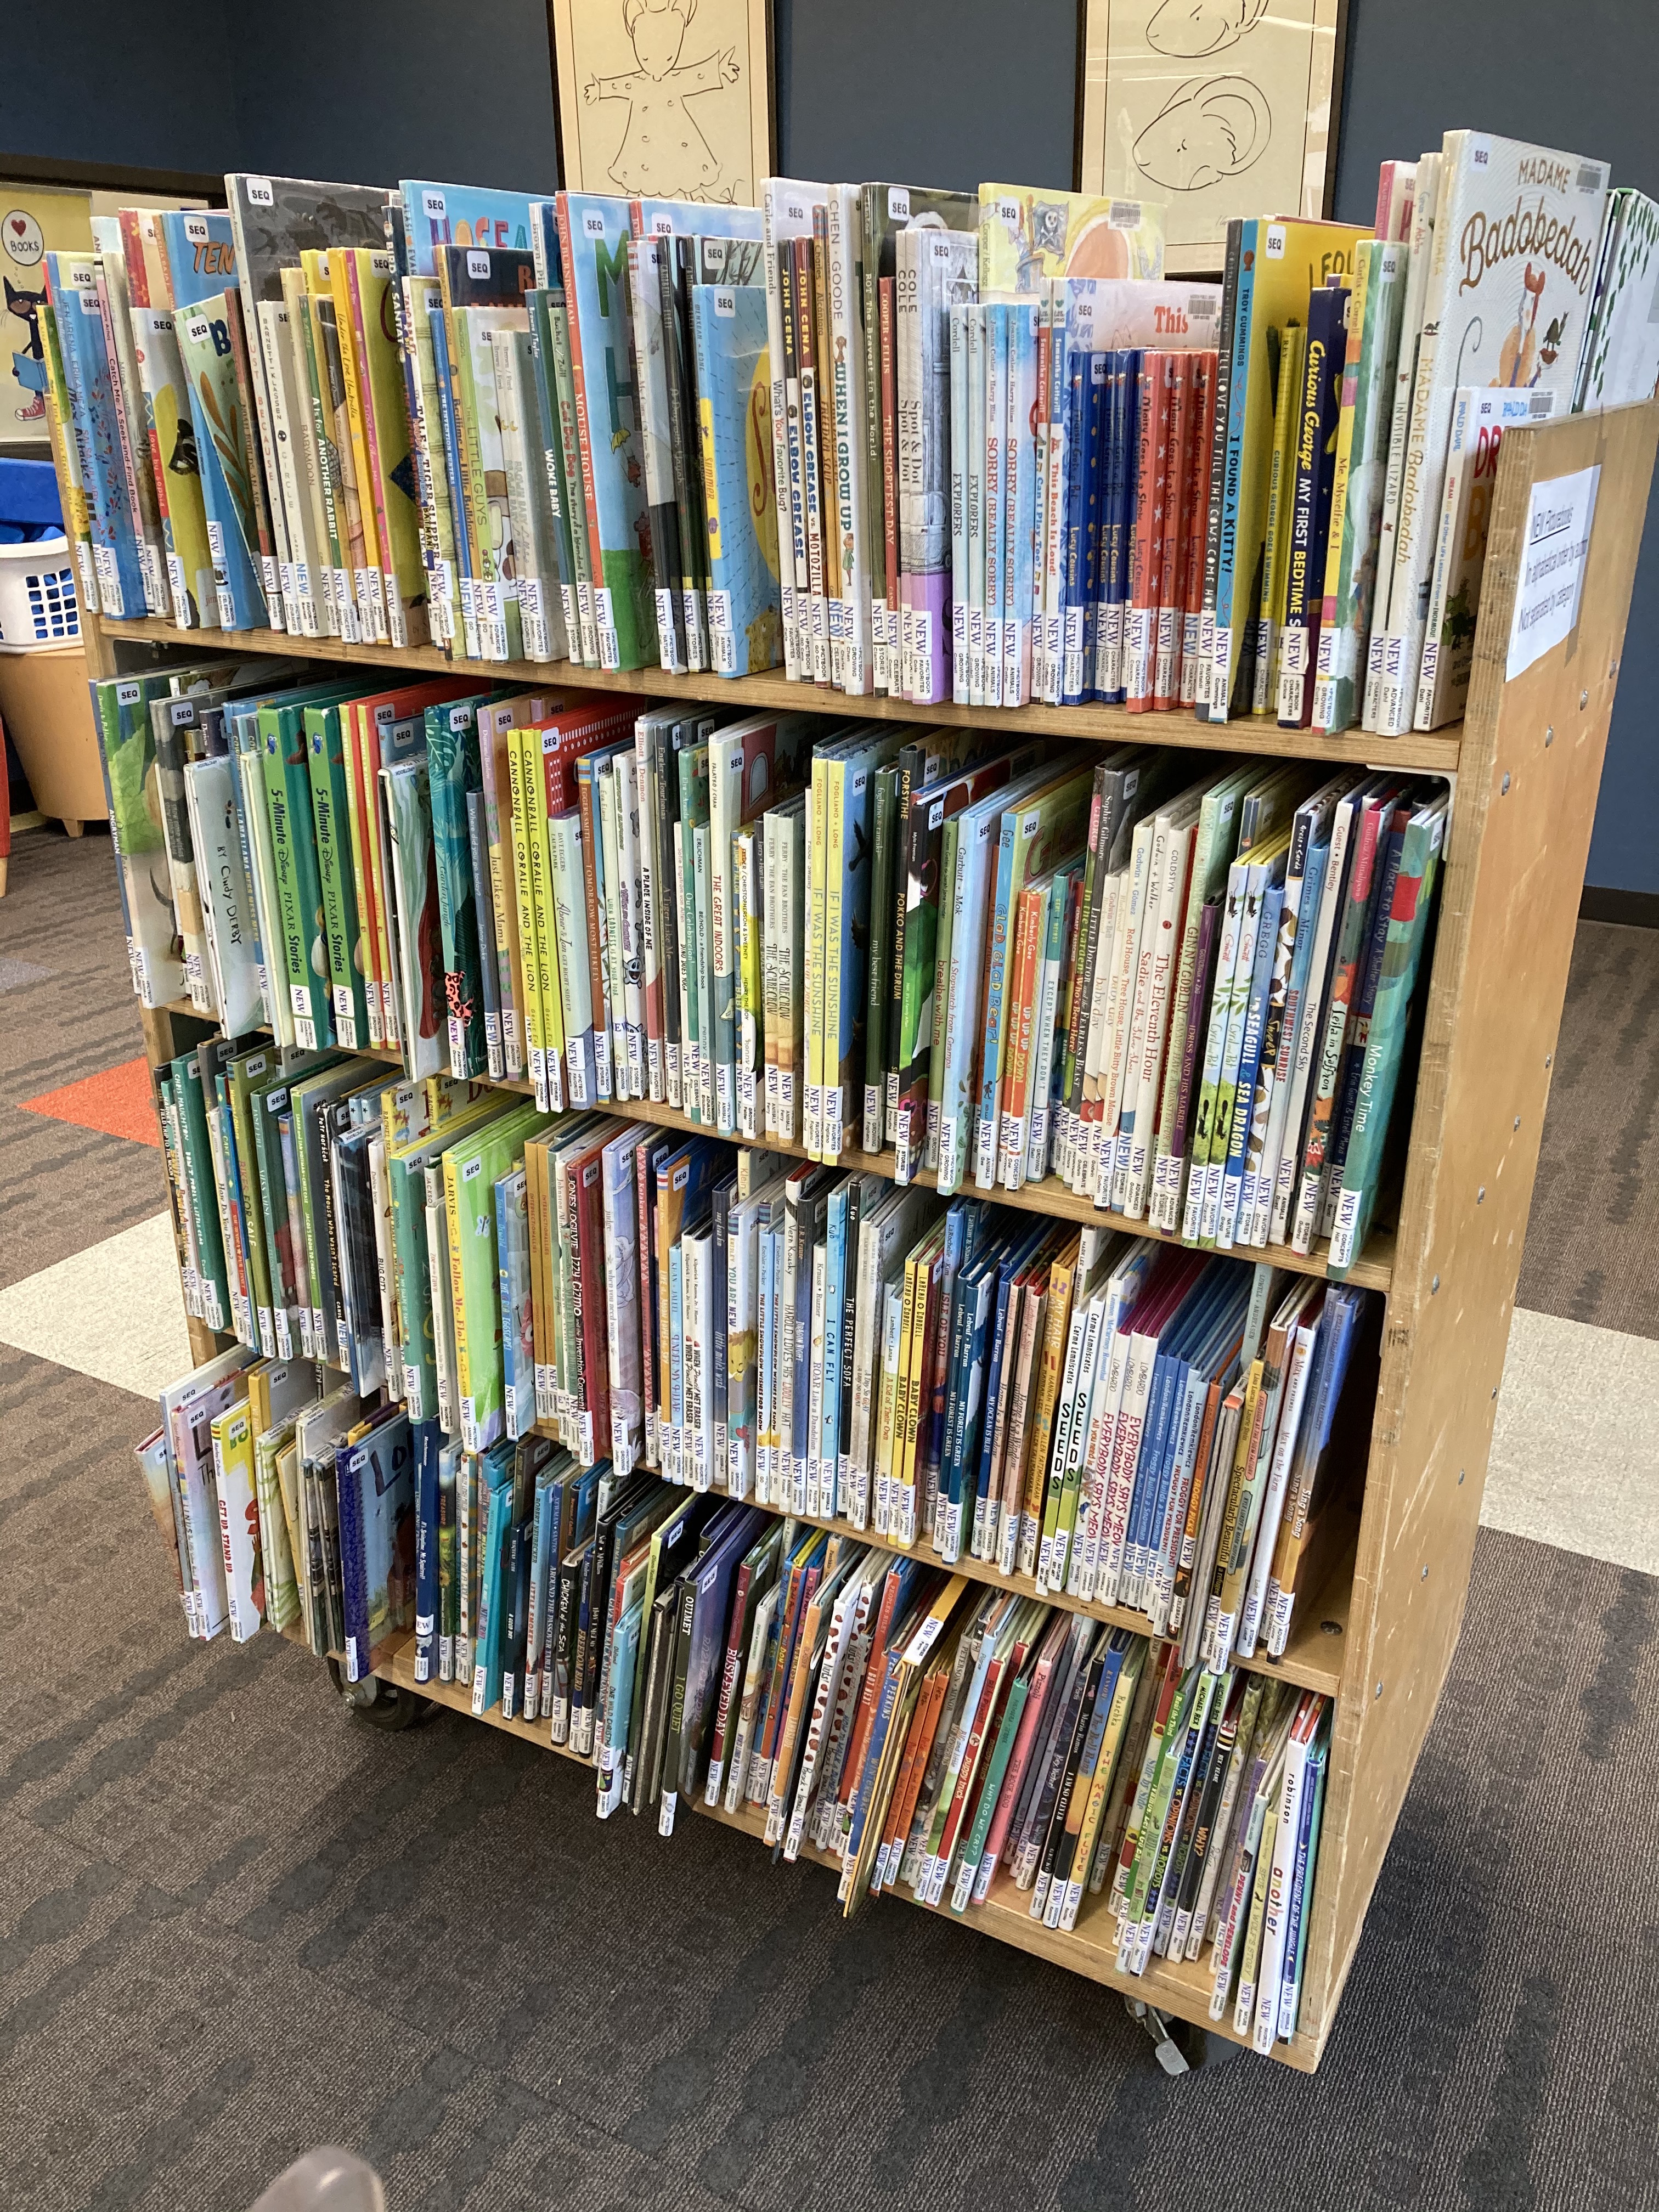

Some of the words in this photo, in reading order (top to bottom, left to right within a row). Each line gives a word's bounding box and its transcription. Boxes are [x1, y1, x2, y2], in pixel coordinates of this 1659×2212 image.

[1474, 150, 1488, 164] SEQ
[1517, 158, 1571, 194] MADAME
[252, 190, 270, 200] SEQ
[764, 194, 773, 228] Carle
[788, 207, 803, 218] SEQ
[189, 225, 206, 235] SEQ
[558, 214, 567, 246] JOHN
[830, 200, 840, 244] CHEN
[10, 240, 40, 251] BOOKS
[193, 241, 236, 275] TEN
[934, 246, 949, 257] SEQ
[1268, 238, 1281, 250] SEQ
[1459, 195, 1592, 297] Badobedah
[472, 263, 488, 273] SEQ
[766, 247, 775, 295] Friends
[561, 248, 575, 325] BURNINGHAM
[799, 268, 808, 308] JOHN
[832, 261, 843, 320] GOODE
[908, 269, 917, 313] COLE
[1240, 288, 1250, 313] TROY
[191, 326, 207, 337] SEQ
[337, 313, 346, 341] Under
[800, 314, 809, 356] CENA
[1154, 306, 1188, 334] This
[1237, 315, 1247, 367] CUMMINGS
[343, 358, 352, 378] Love
[1308, 340, 1325, 409] Curious
[346, 379, 357, 419] Umbrella
[772, 380, 782, 416] What's
[835, 363, 848, 424] WHEN
[575, 393, 588, 449] MOUSE
[775, 417, 783, 444] Your
[804, 393, 815, 446] ELBOW
[911, 400, 921, 434] Spot
[1392, 401, 1405, 462] INVISIBLE
[109, 358, 119, 387] Catch
[119, 418, 133, 487] Seek-and-Find
[128, 488, 137, 513] Book
[911, 441, 922, 451] &
[1297, 413, 1320, 470] George
[302, 425, 315, 486] BABYMOON
[318, 439, 331, 495] ANOTHER
[544, 449, 556, 485] WOKE
[775, 444, 785, 486] Favorite
[838, 444, 850, 503] GROW
[912, 457, 922, 484] Dot
[987, 438, 998, 494] SORRY
[1227, 448, 1239, 498] FOUND
[1338, 457, 1348, 476] Me,
[281, 452, 294, 508] CIRCLE
[579, 452, 592, 501] HOUSE
[806, 449, 817, 513] GREASE
[1298, 478, 1311, 503] MY
[1387, 463, 1401, 505] LIZARD
[549, 488, 562, 518] BABY
[779, 488, 787, 512] Bug?
[953, 473, 962, 537] EXPLORERS
[1051, 492, 1059, 524] Beach
[1226, 503, 1235, 515] A
[1331, 482, 1346, 527] Myselfie
[324, 498, 337, 540] RABBIT
[840, 507, 851, 531] UP
[987, 498, 997, 555] (REALLY
[1050, 526, 1057, 539] Is
[1294, 507, 1309, 546] FIRST
[1331, 531, 1340, 540] &
[1223, 518, 1235, 574] KITTY!
[168, 560, 179, 588] NEW
[809, 533, 821, 596] MOTOZILLA
[987, 557, 997, 606] SORRY)
[1290, 550, 1306, 614] BEDTIME
[221, 595, 231, 623] CELEBRATE
[916, 619, 927, 654] NEW
[1387, 638, 1401, 676] NEW
[176, 709, 193, 719] SEQ
[453, 713, 469, 725] SEQ
[1389, 687, 1397, 727] ADVANCED
[524, 750, 538, 834] CANNONBALL
[901, 769, 910, 820] FORSYTHE
[109, 809, 121, 854] ANGRYMAN
[270, 789, 285, 845] 5-Minute
[1024, 821, 1037, 834] SEQ
[1334, 826, 1345, 855] Guest
[278, 845, 291, 885] Disney
[532, 842, 543, 896] CORALIE
[1167, 849, 1179, 893] GOLDSTYN
[1325, 861, 1339, 891] Bentley
[217, 846, 225, 859] BY
[221, 865, 233, 899] Cindy
[227, 905, 242, 945] DERBY
[713, 875, 721, 892] THE
[283, 891, 296, 931] PIXAR
[536, 904, 545, 928] AND
[713, 895, 723, 927] GREAT
[896, 893, 905, 927] POKKO
[539, 936, 548, 959] THE
[714, 930, 724, 972] INDOORS
[895, 930, 904, 950] AND
[1257, 911, 1272, 958] GREGG
[289, 934, 301, 974] Stories
[895, 952, 903, 968] THE
[1156, 953, 1170, 975] The
[540, 963, 550, 991] LION
[779, 967, 791, 1021] SCARECROW
[893, 969, 904, 1000] DRUM
[1147, 980, 1166, 1039] Eleventh
[1242, 1013, 1260, 1063] SEAGULL
[1142, 1045, 1159, 1082] Hour
[1295, 1054, 1310, 1072] Sky
[1319, 1050, 1339, 1091] Saffron
[1359, 1044, 1384, 1098] Monkey
[1238, 1081, 1251, 1103] SEA
[1229, 1109, 1248, 1157] DRAGON
[1355, 1100, 1373, 1133] Time
[466, 1164, 480, 1177] SEQ
[447, 1175, 456, 1216] JARVIS
[1340, 1194, 1356, 1227] NEW
[451, 1258, 462, 1291] Follow
[845, 1298, 854, 1314] THE
[843, 1316, 854, 1361] PERFECT
[843, 1364, 852, 1387] SOFA
[191, 1410, 204, 1424] SEQ
[1066, 1392, 1088, 1483] SEEDS
[218, 1499, 227, 1516] GET
[1228, 1465, 1245, 1525] Spectacularly
[222, 1534, 230, 1557] STAND
[1221, 1526, 1234, 1568] Beautiful
[225, 1561, 233, 1574] UP
[562, 1578, 572, 1614] CHICKEN
[681, 1595, 695, 1635] OUIMET
[925, 1618, 940, 1638] NEW
[557, 1637, 567, 1653] SEA
[676, 1684, 685, 1700] GO
[670, 1702, 684, 1734] QUIET
[1281, 1772, 1296, 1825] robinson
[1194, 1826, 1209, 1858] WHY?
[1235, 1874, 1247, 1900] PENNY
[1266, 1866, 1284, 1937] another
[1220, 1918, 1237, 1967] PENELOPE
